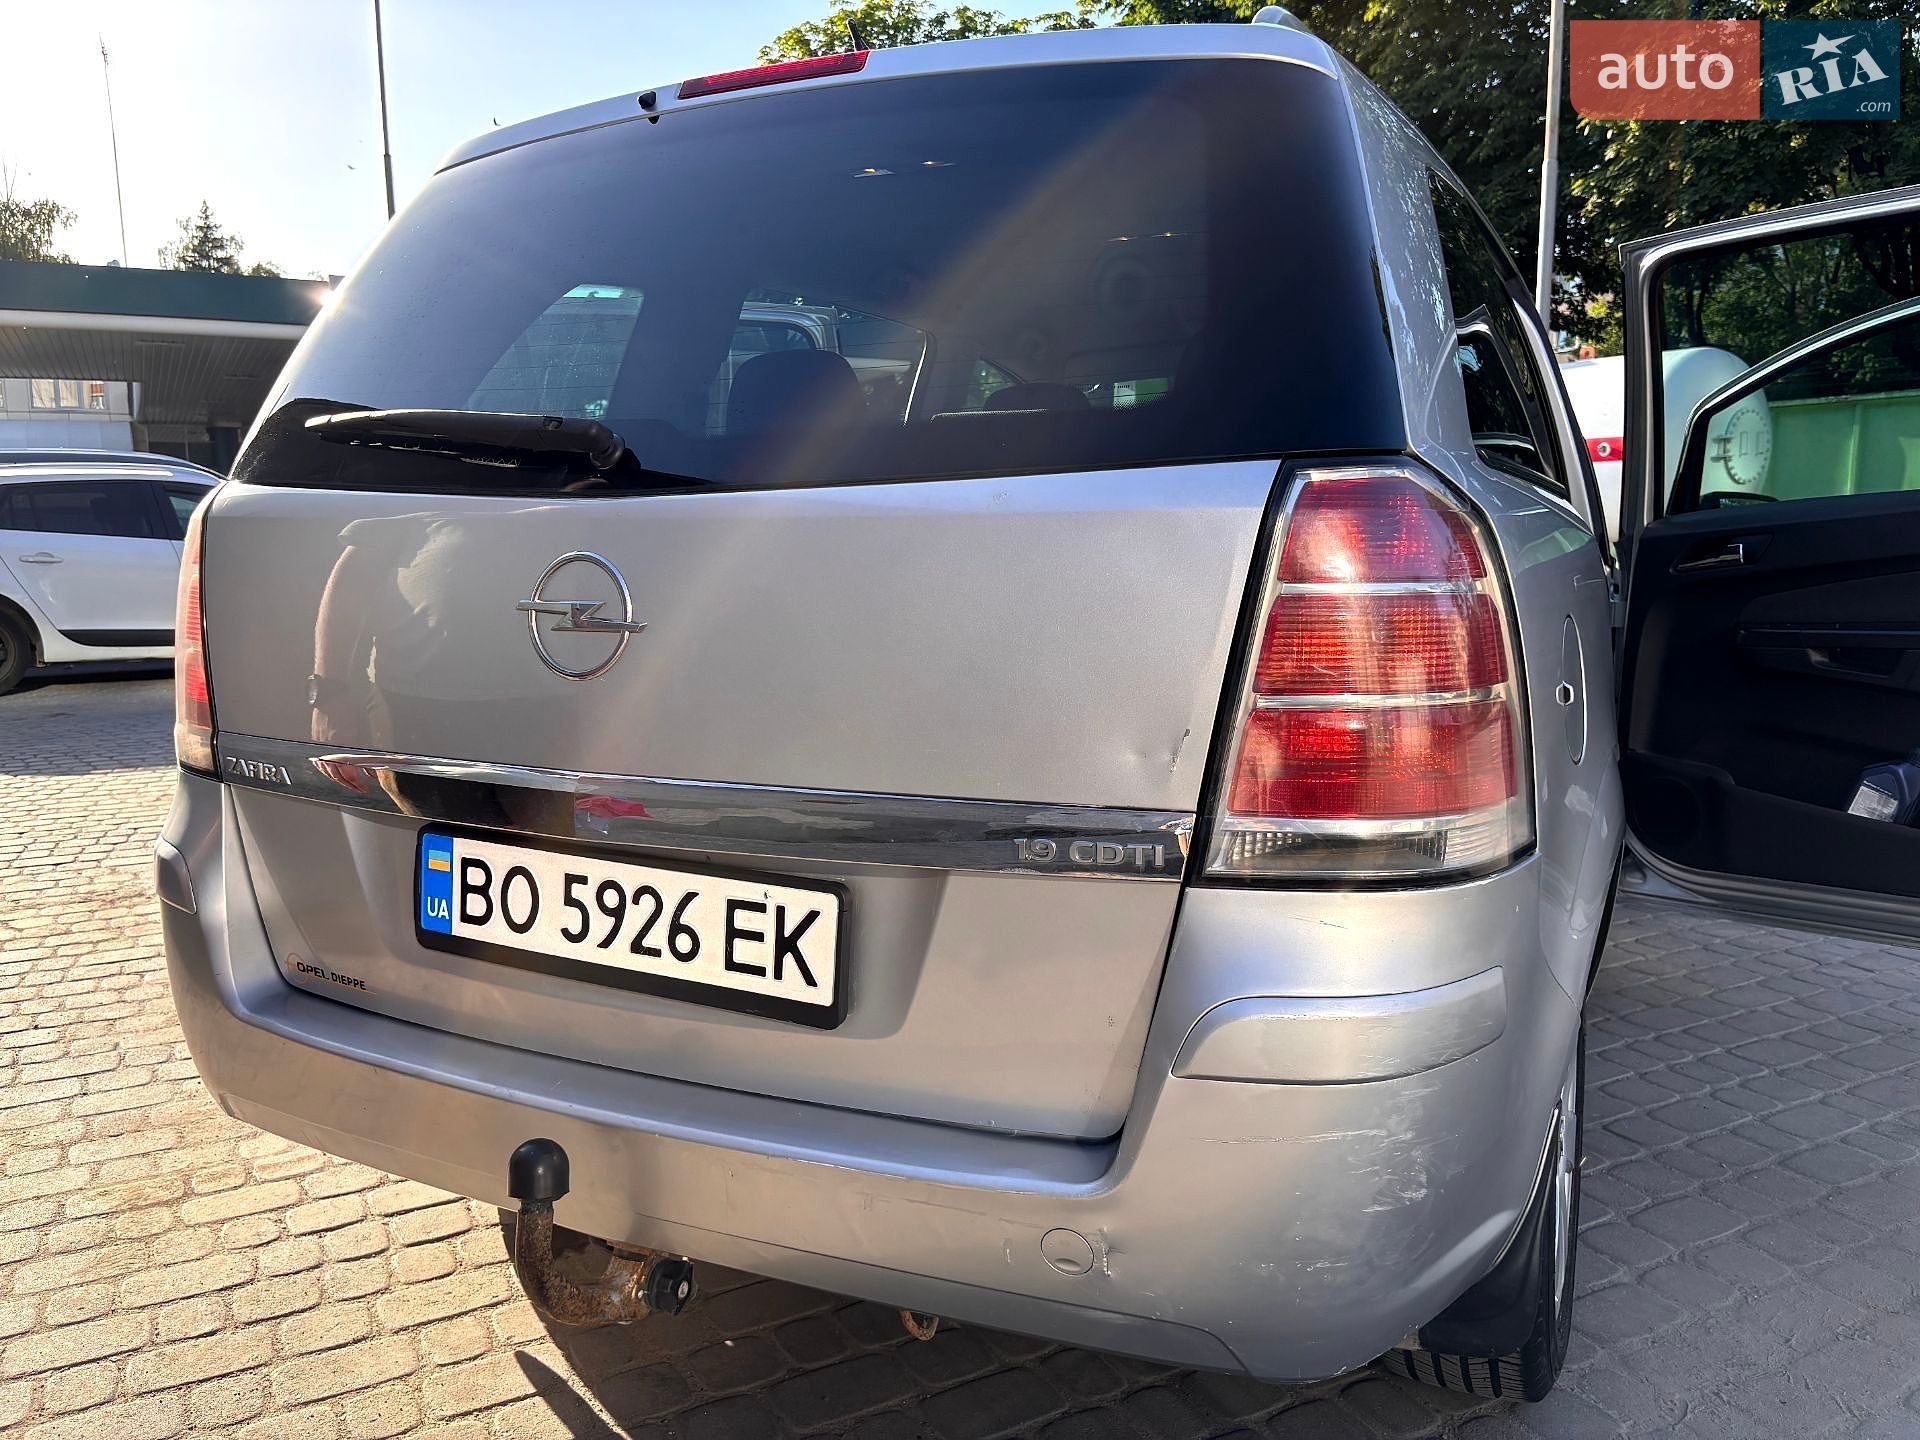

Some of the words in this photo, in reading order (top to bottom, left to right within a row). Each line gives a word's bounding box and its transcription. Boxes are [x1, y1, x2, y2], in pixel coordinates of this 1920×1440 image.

[226, 756, 292, 785] ZAFIRA
[1069, 840, 1164, 866] CDTI
[428, 896, 450, 920] UA
[460, 857, 540, 934] BO
[560, 873, 701, 962] 5926
[724, 898, 821, 988] EK
[296, 962, 329, 980] OPEL
[330, 972, 367, 990] DIEPPE
